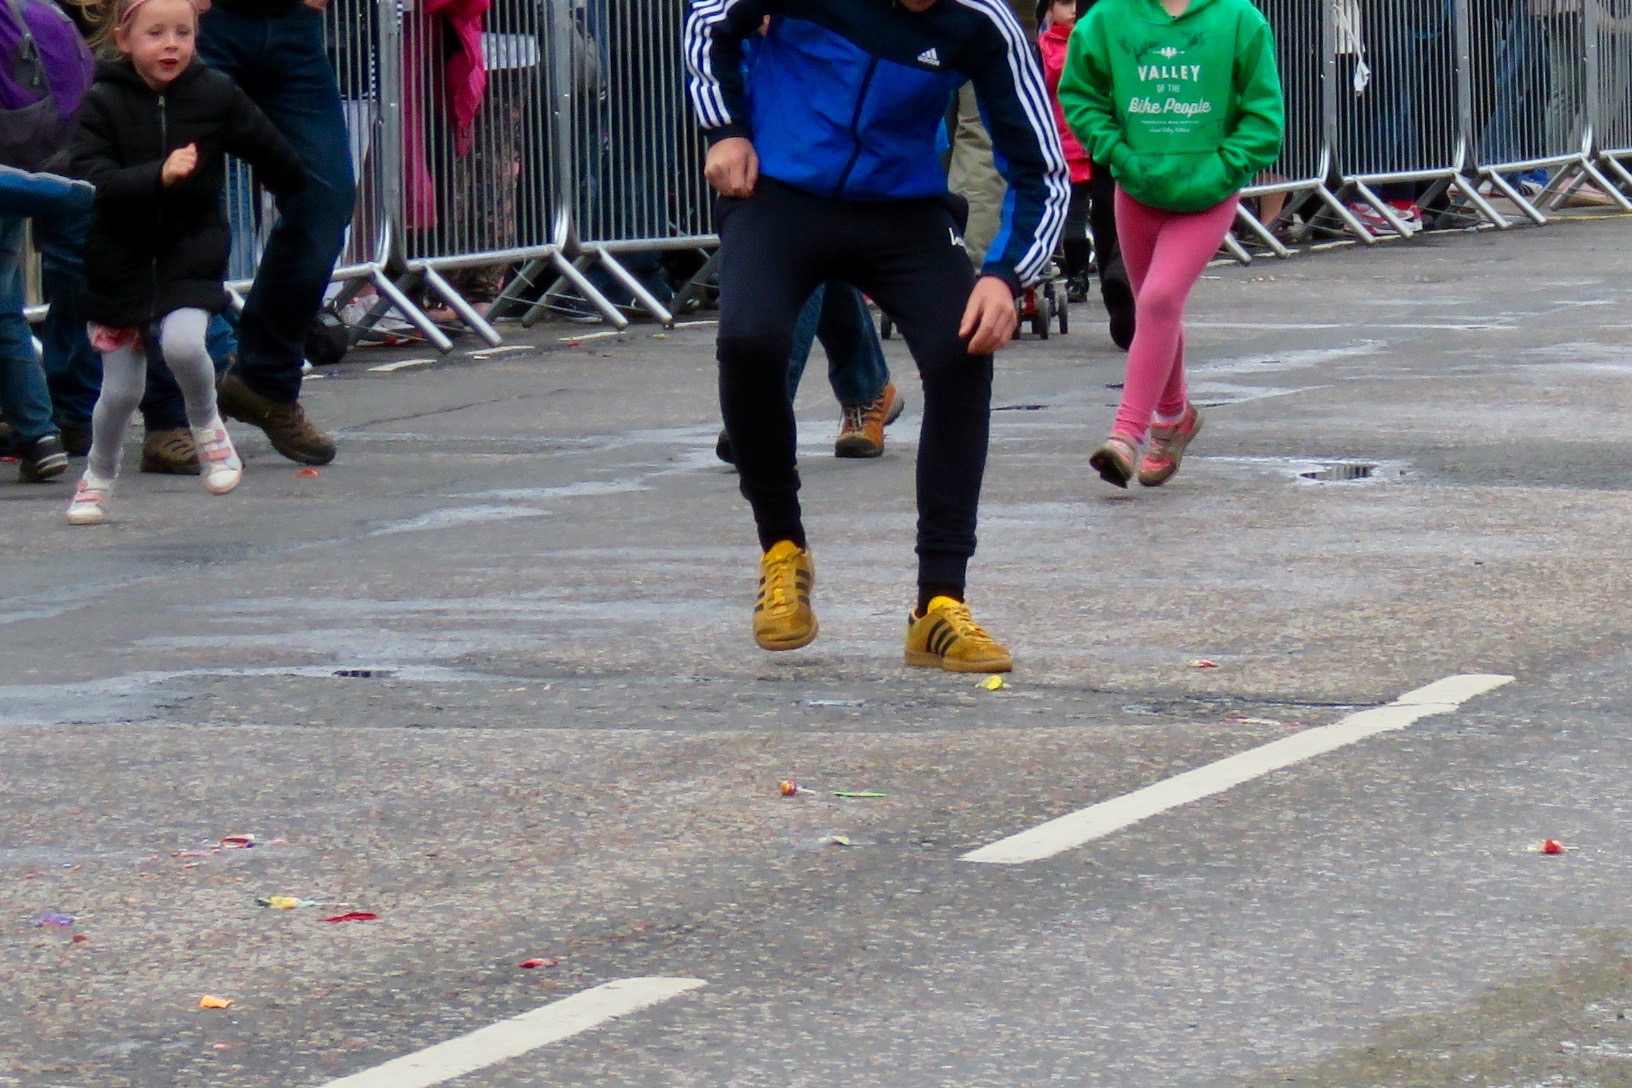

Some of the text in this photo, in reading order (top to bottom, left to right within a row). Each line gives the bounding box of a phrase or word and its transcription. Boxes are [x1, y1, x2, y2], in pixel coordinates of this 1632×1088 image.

[1137, 64, 1201, 81] VALLEY
[1156, 84, 1181, 94] OF THE
[1128, 97, 1212, 118] Bike People
